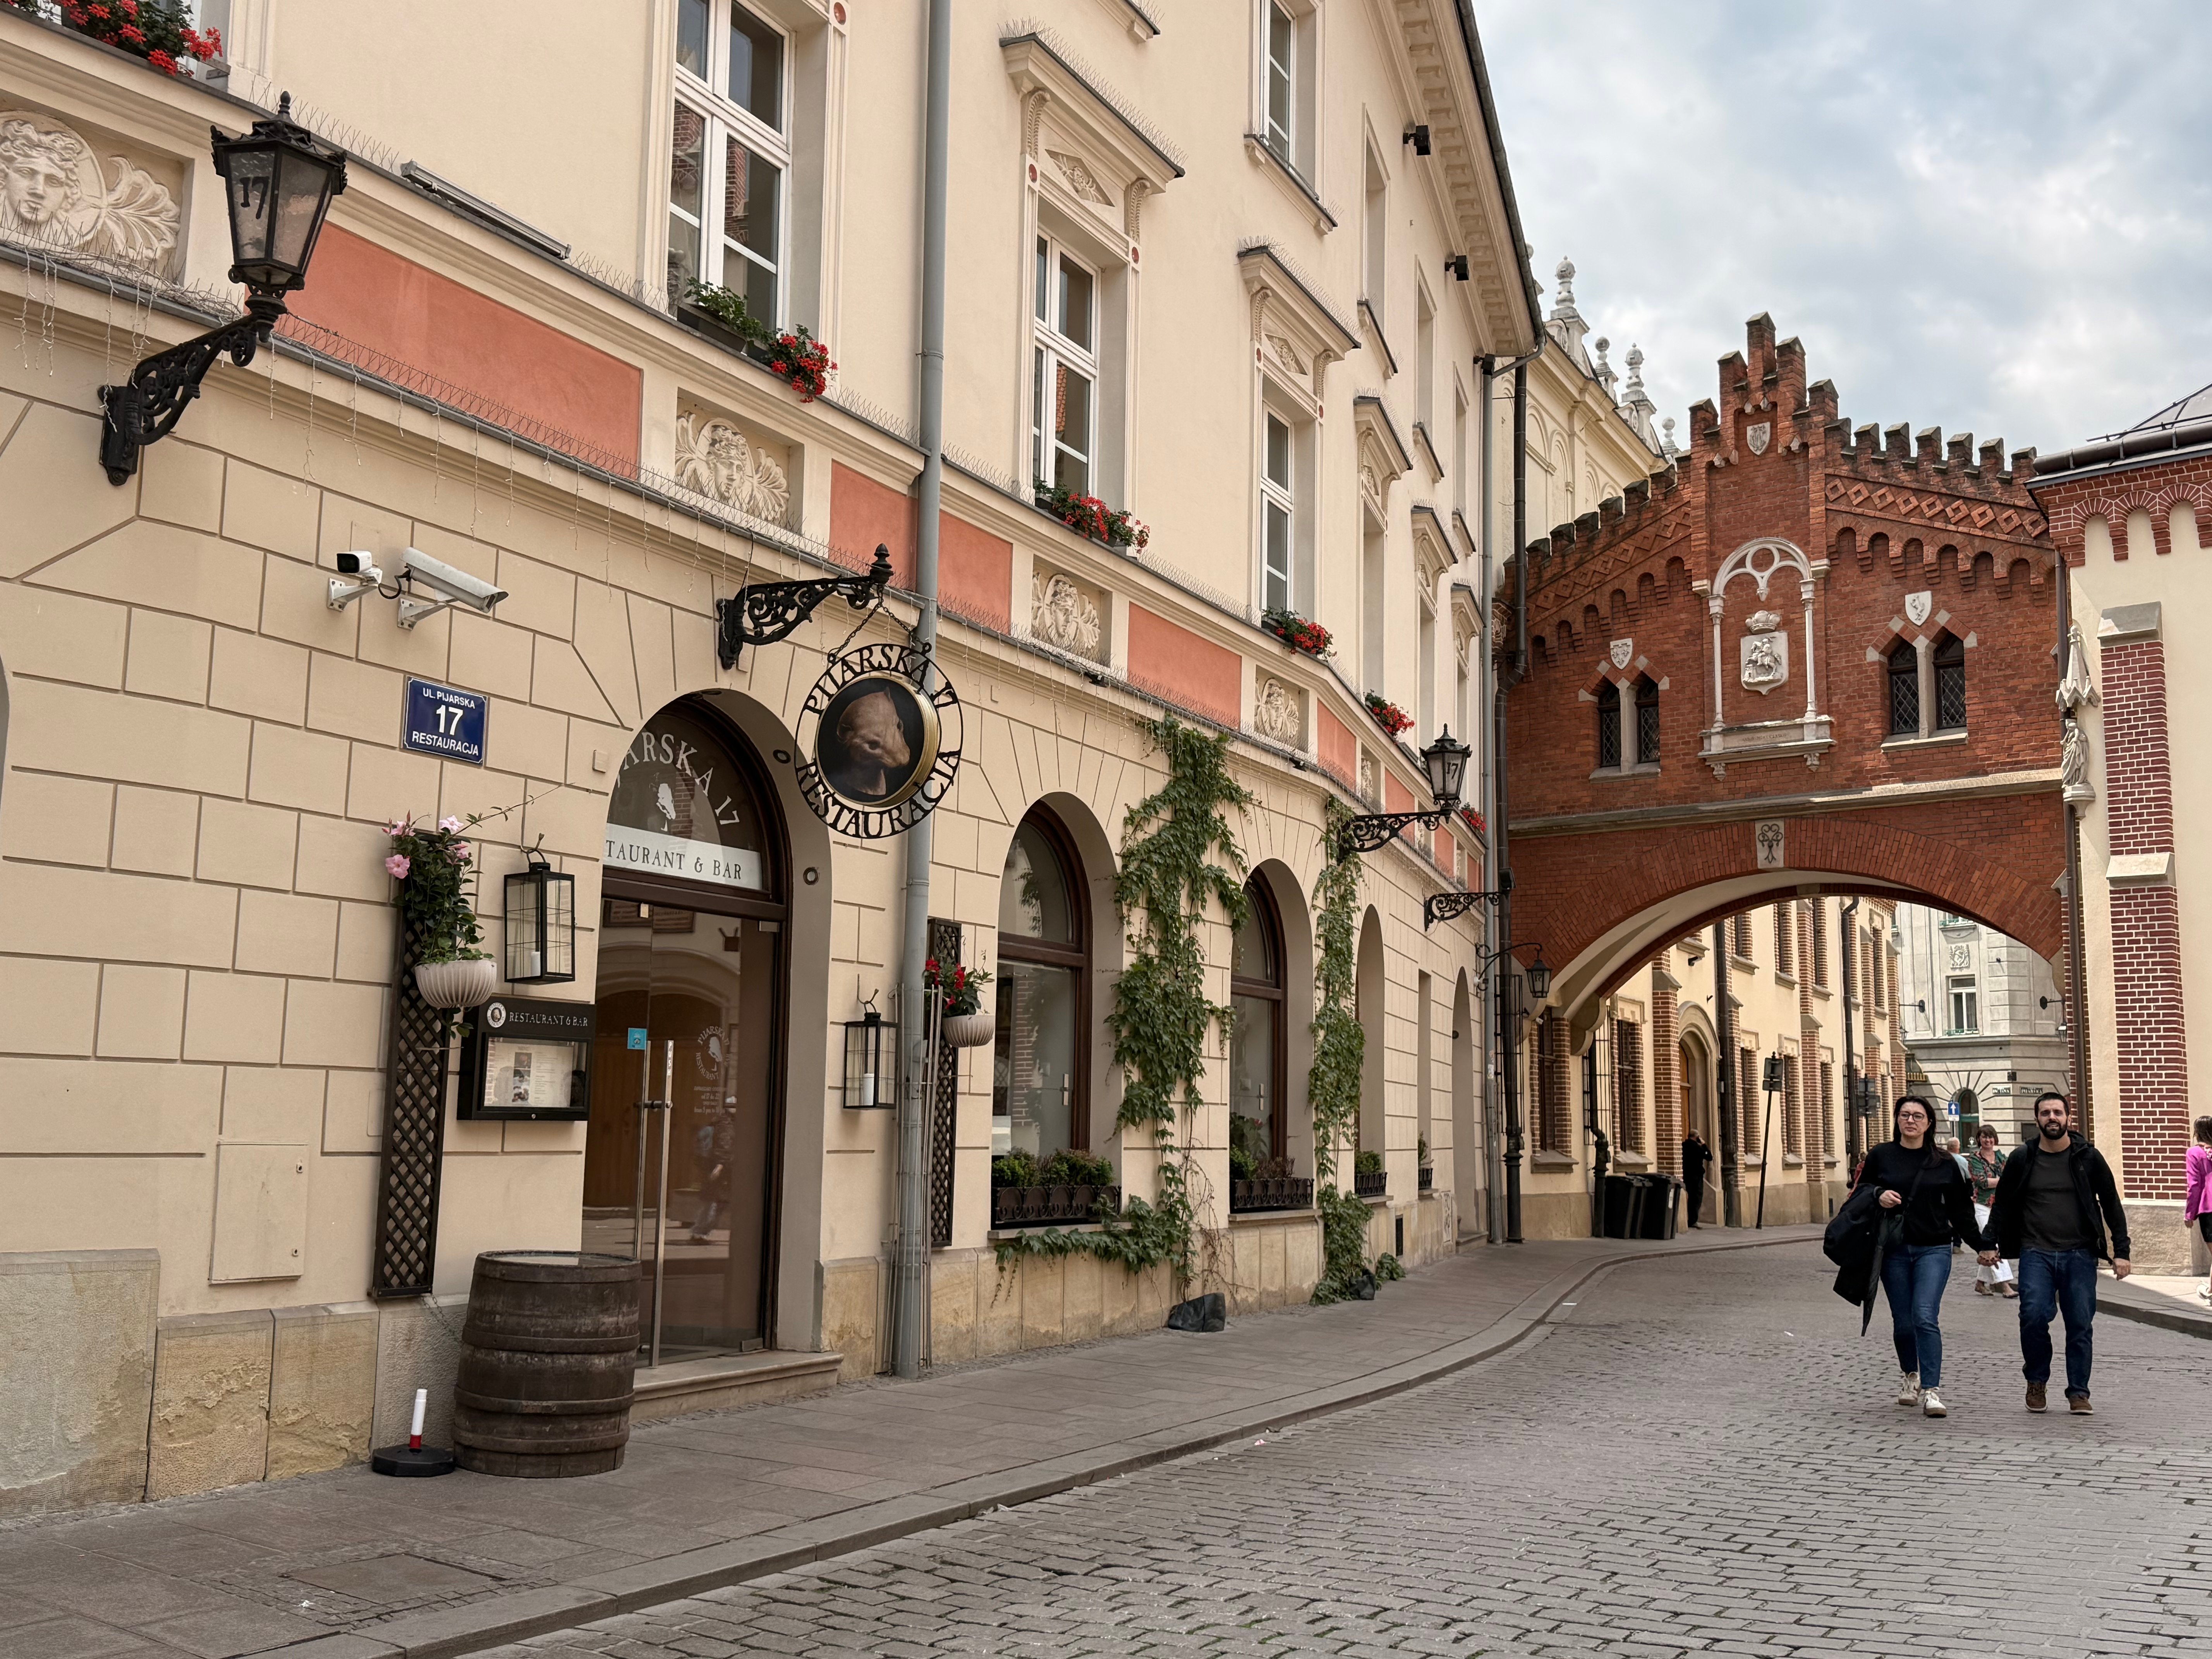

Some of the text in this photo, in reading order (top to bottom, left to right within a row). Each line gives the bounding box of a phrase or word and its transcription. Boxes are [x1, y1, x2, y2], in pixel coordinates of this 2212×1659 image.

[240, 176, 270, 220] 17
[423, 688, 475, 709] UL. PIJARSKA
[930, 682, 958, 708] 17
[436, 705, 463, 735] 17
[412, 731, 479, 756] RESTAURACJA
[1446, 762, 1458, 780] 17
[795, 750, 961, 838] RESTAURACJA
[715, 796, 740, 825] 17
[694, 857, 704, 873] &
[713, 859, 742, 880] BAR
[509, 1012, 564, 1025] RESTAURANT
[566, 1016, 571, 1025] &
[573, 1016, 588, 1026] BAR
